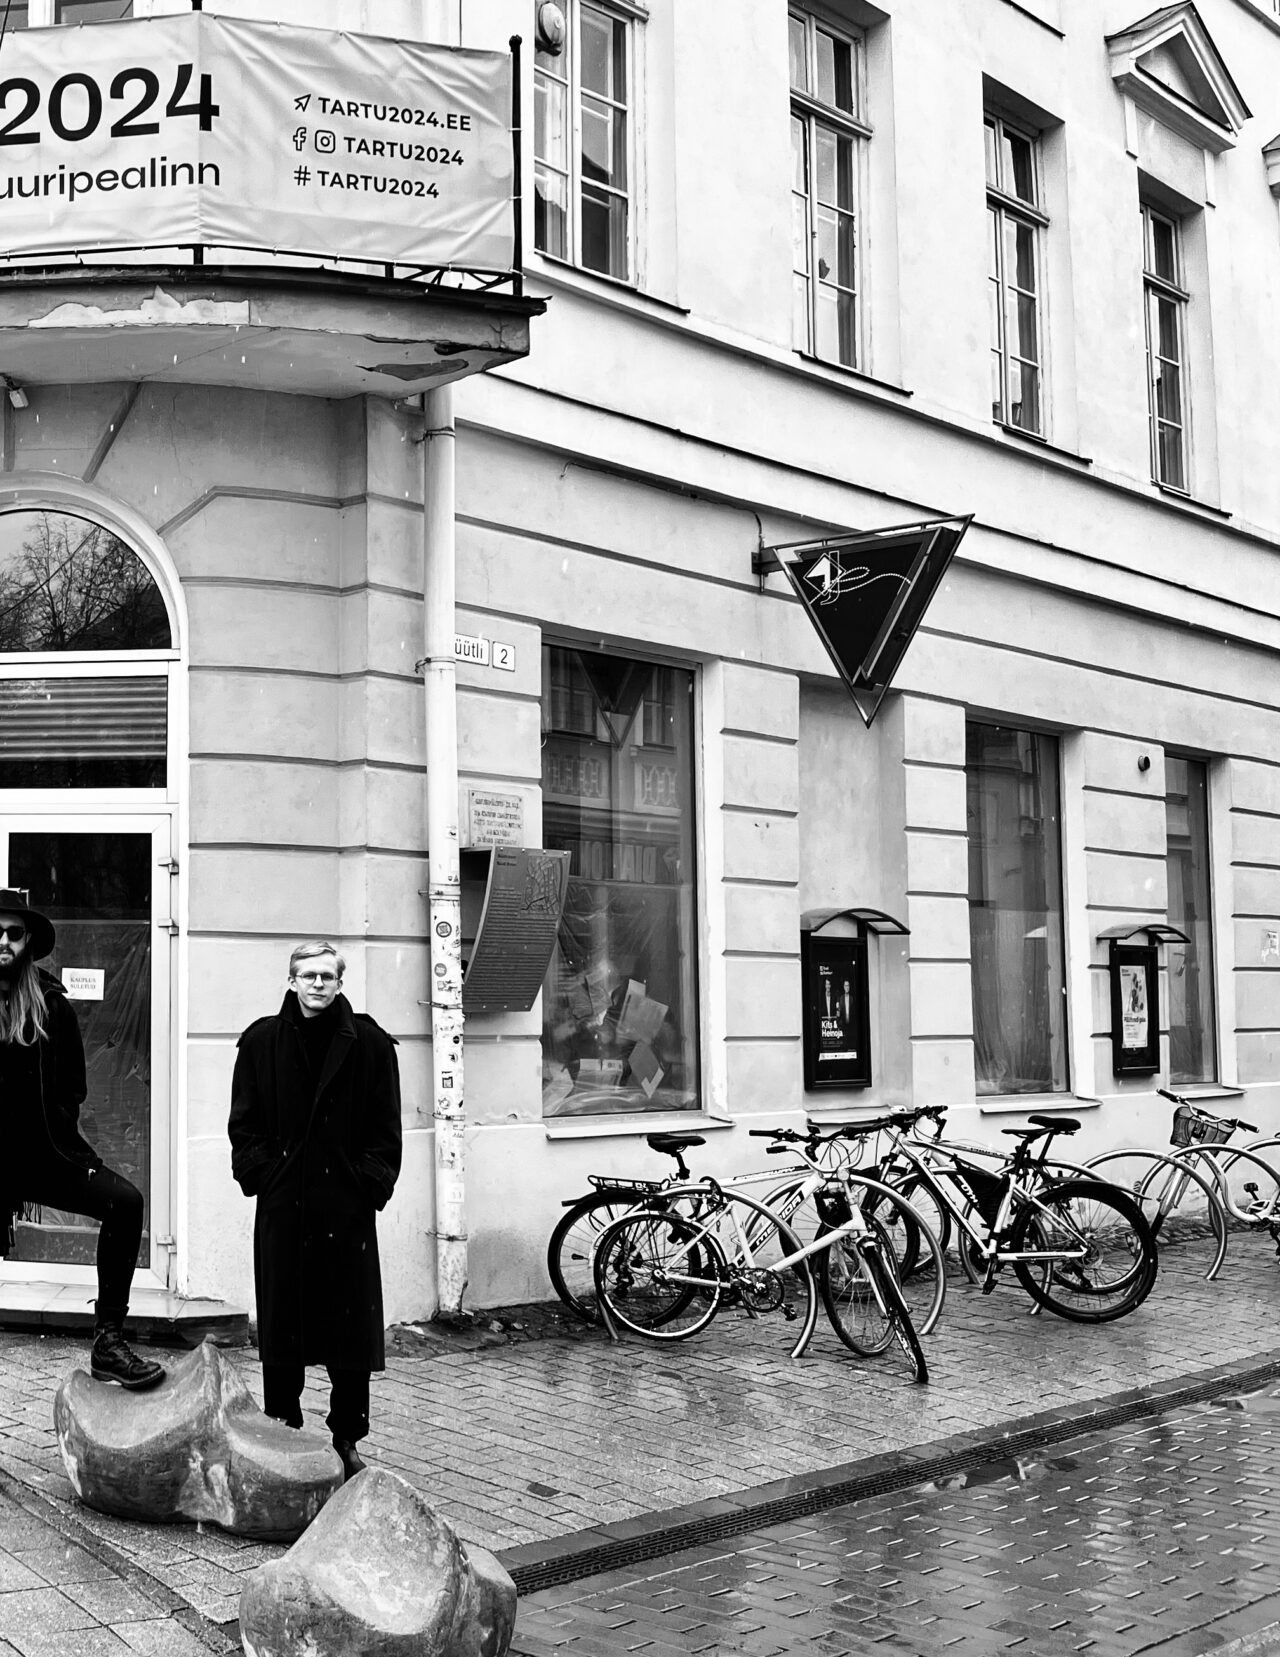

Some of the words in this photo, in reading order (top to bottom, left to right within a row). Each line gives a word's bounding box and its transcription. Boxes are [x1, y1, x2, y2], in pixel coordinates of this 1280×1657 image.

[317, 96, 472, 132] TARTU2024.EE
[343, 136, 465, 166] TARTU2024
[455, 638, 483, 659] üütli
[500, 648, 508, 665] 2
[756, 1194, 802, 1246] MEIDA
